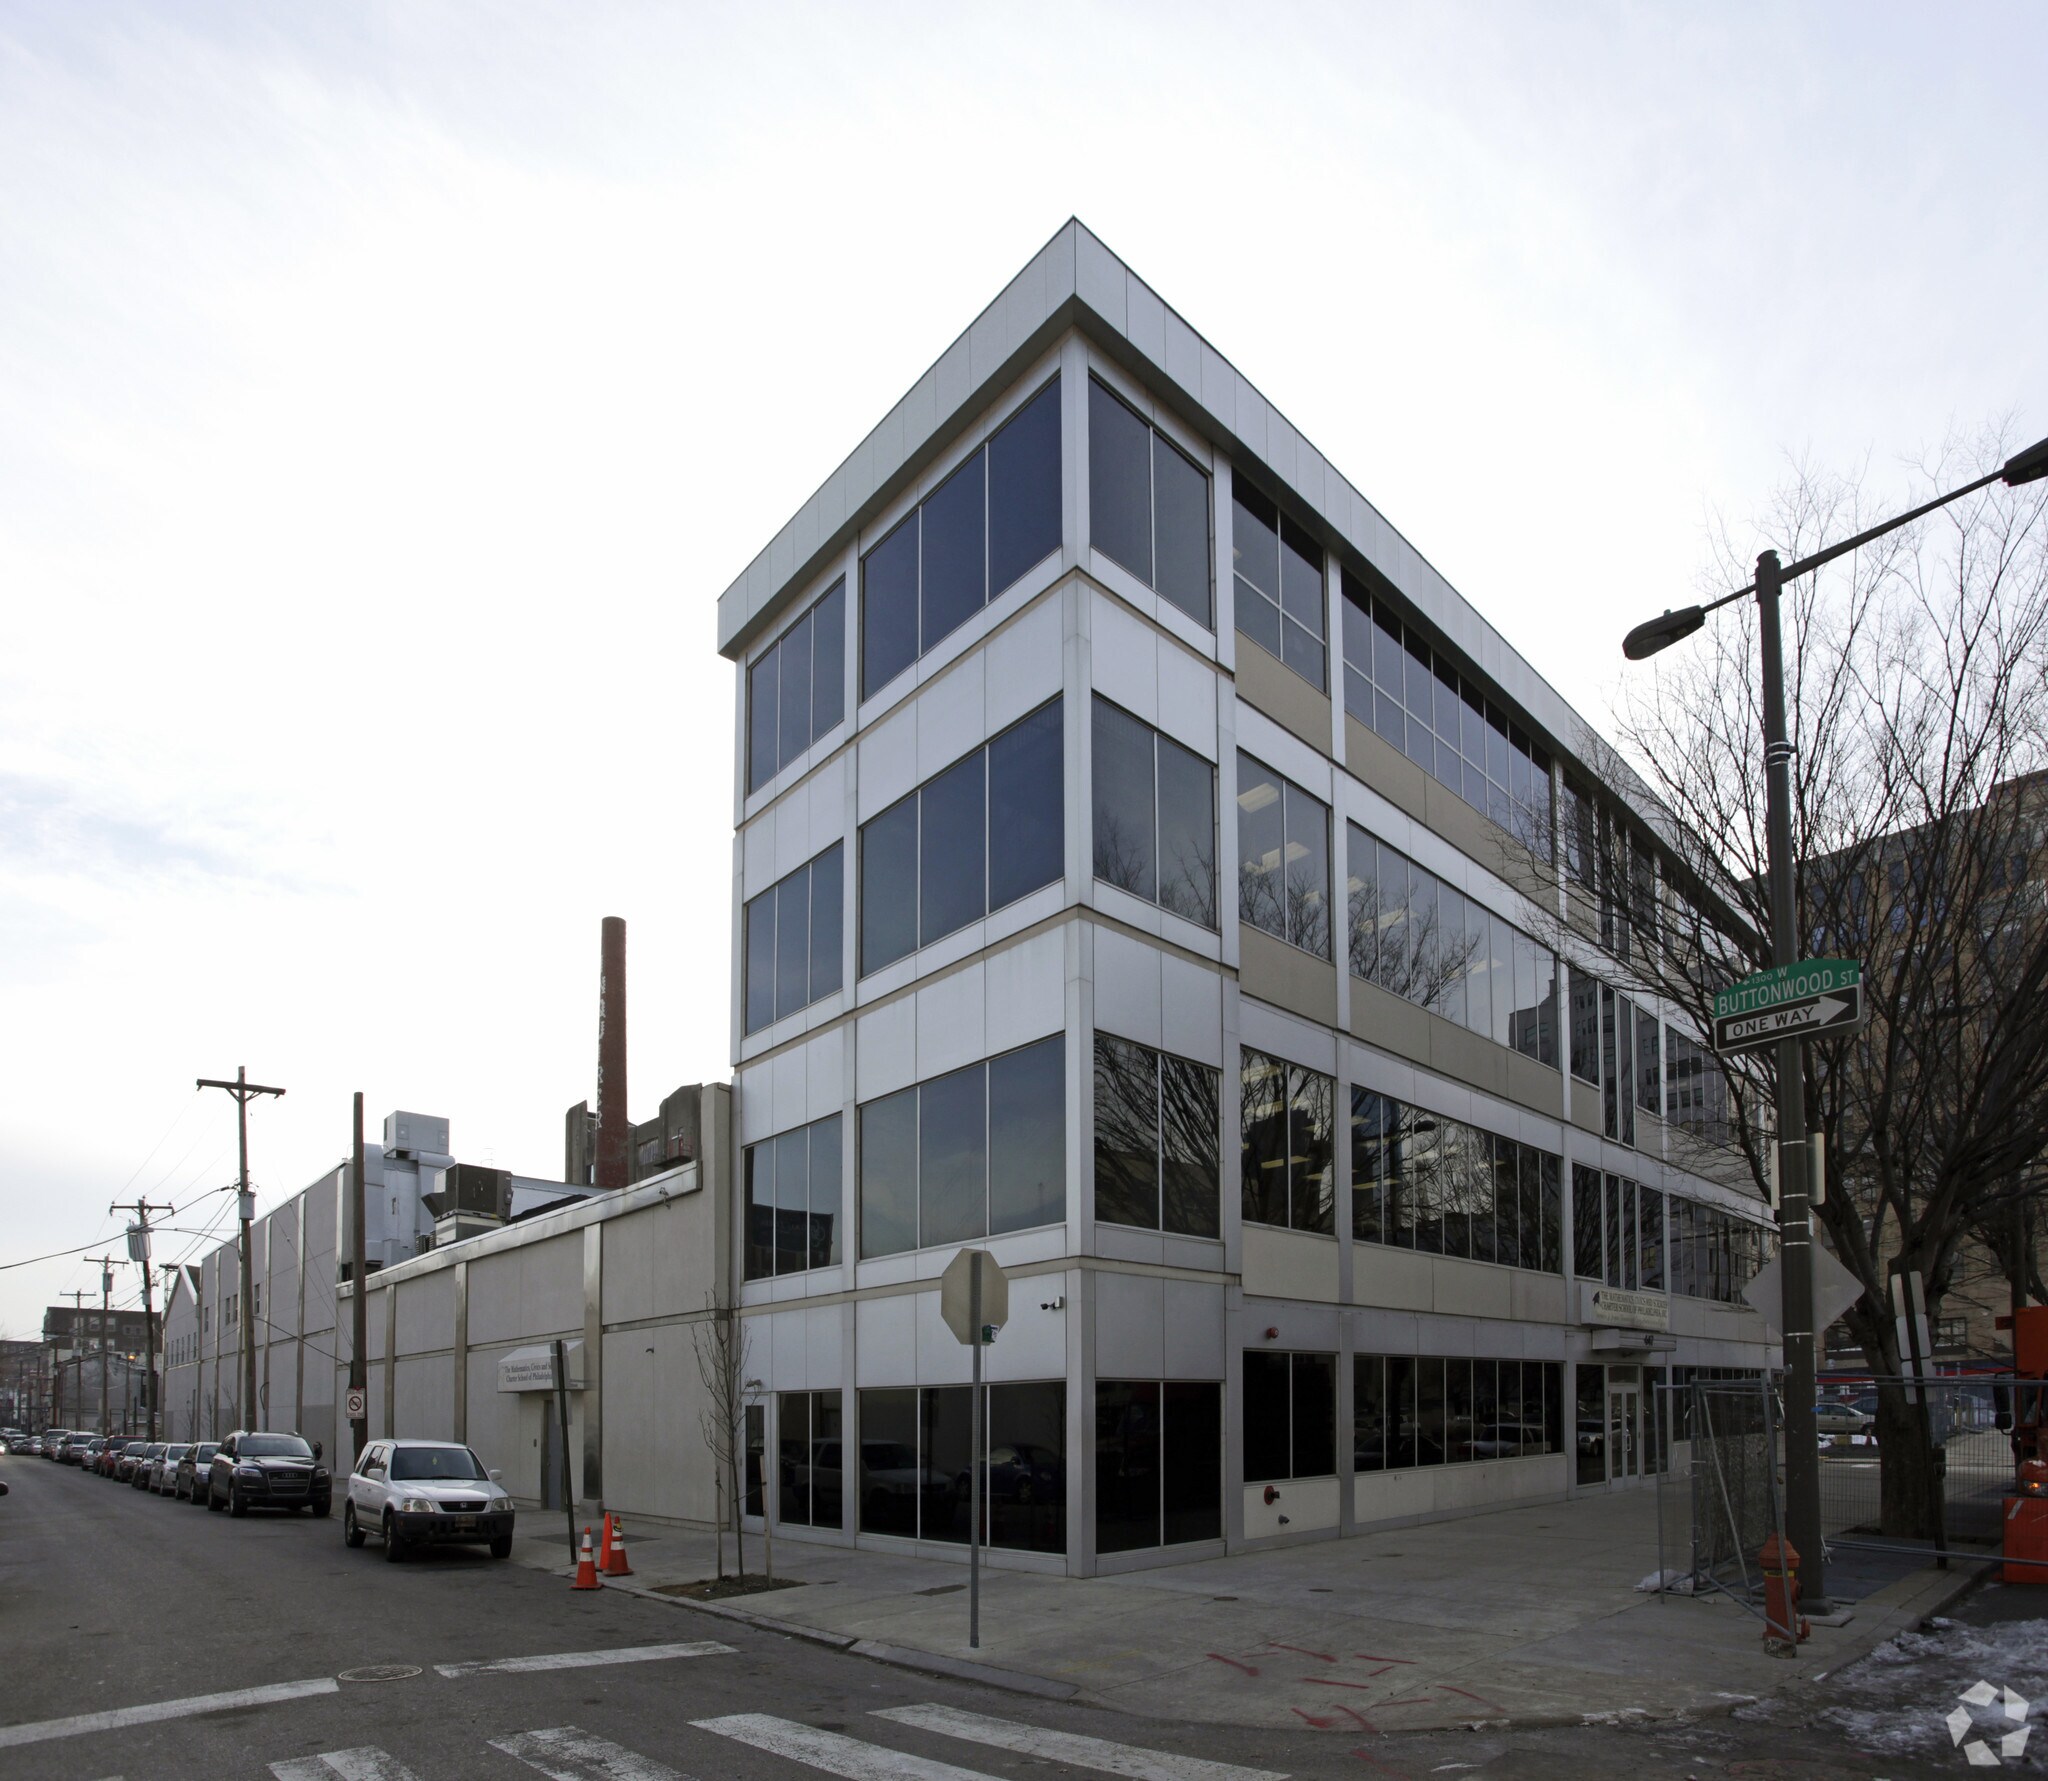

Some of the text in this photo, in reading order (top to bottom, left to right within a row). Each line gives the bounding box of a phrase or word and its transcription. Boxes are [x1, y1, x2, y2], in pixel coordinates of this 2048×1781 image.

[1751, 966, 1788, 985] 1300 W
[1718, 969, 1854, 1015] BUTTONWOOD ST
[1733, 1006, 1814, 1037] ONE WAY
[1601, 1291, 1609, 1300] THE
[1618, 1303, 1633, 1314] SCHOOL
[506, 1374, 518, 1383] Charter
[518, 1372, 528, 1382] School
